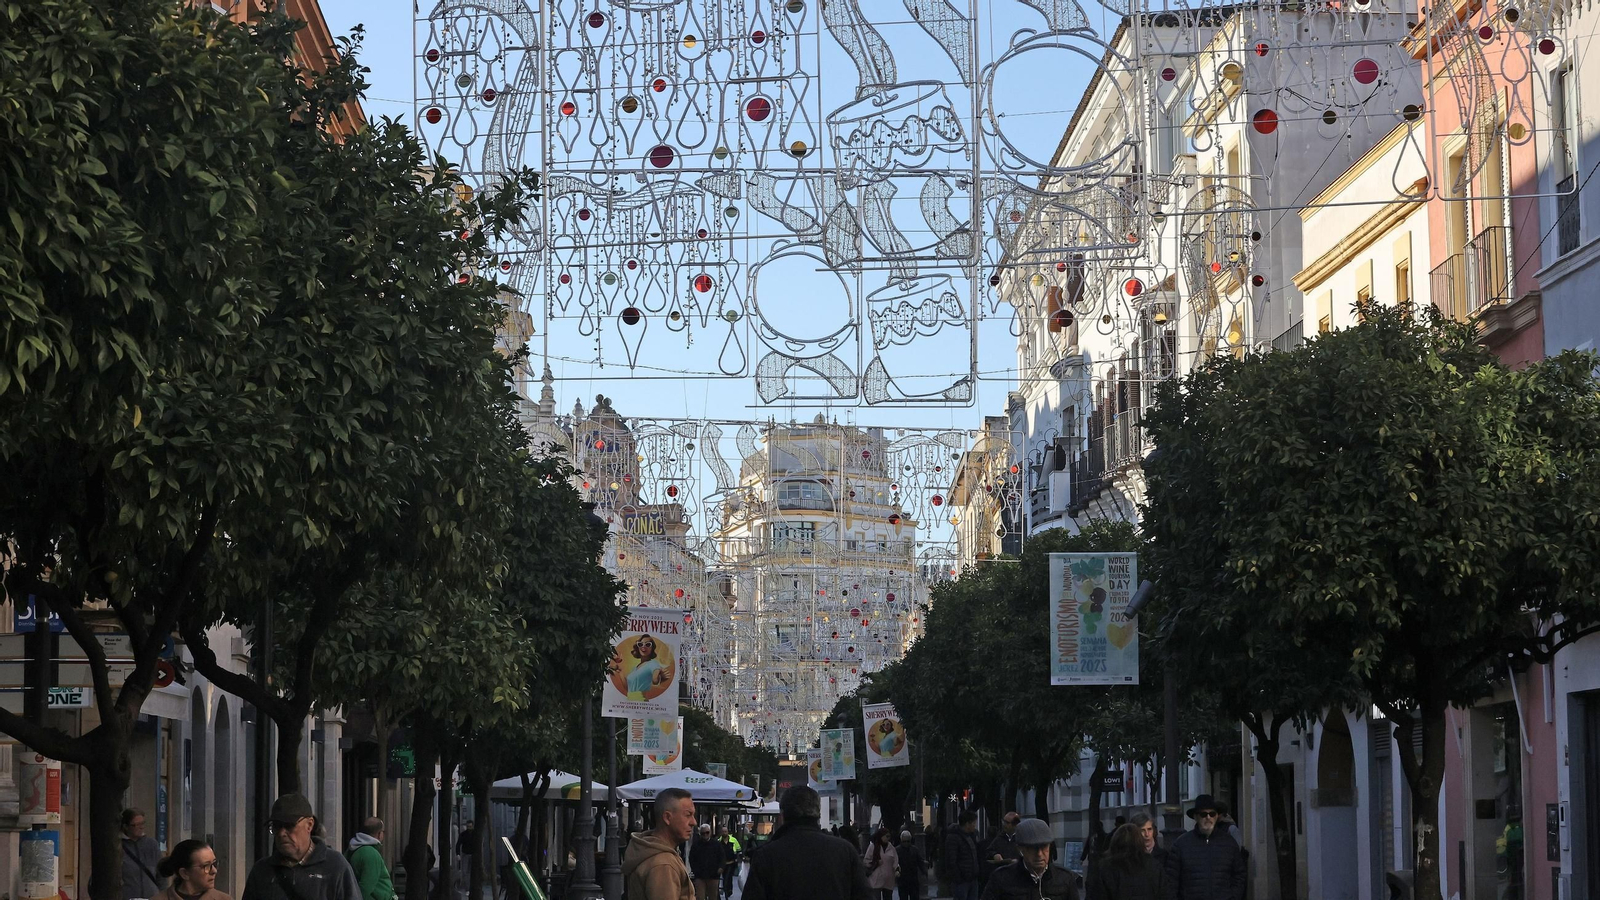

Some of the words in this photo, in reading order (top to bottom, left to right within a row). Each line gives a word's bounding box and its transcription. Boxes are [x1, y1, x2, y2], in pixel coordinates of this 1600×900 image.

[627, 514, 663, 535] COÑAC
[1108, 556, 1130, 564] WORLD
[1108, 565, 1130, 573] WINE
[1109, 580, 1131, 590] DAY
[622, 619, 679, 635] ERRYWEEK
[1057, 599, 1079, 663] ENOTURISMO
[1080, 637, 1107, 645] SEMANA
[1058, 664, 1079, 672] JEREZ
[1080, 659, 1107, 672] 2025
[48, 693, 82, 704] ONE
[631, 718, 645, 742] ENOTUR
[643, 739, 660, 748] 2025
